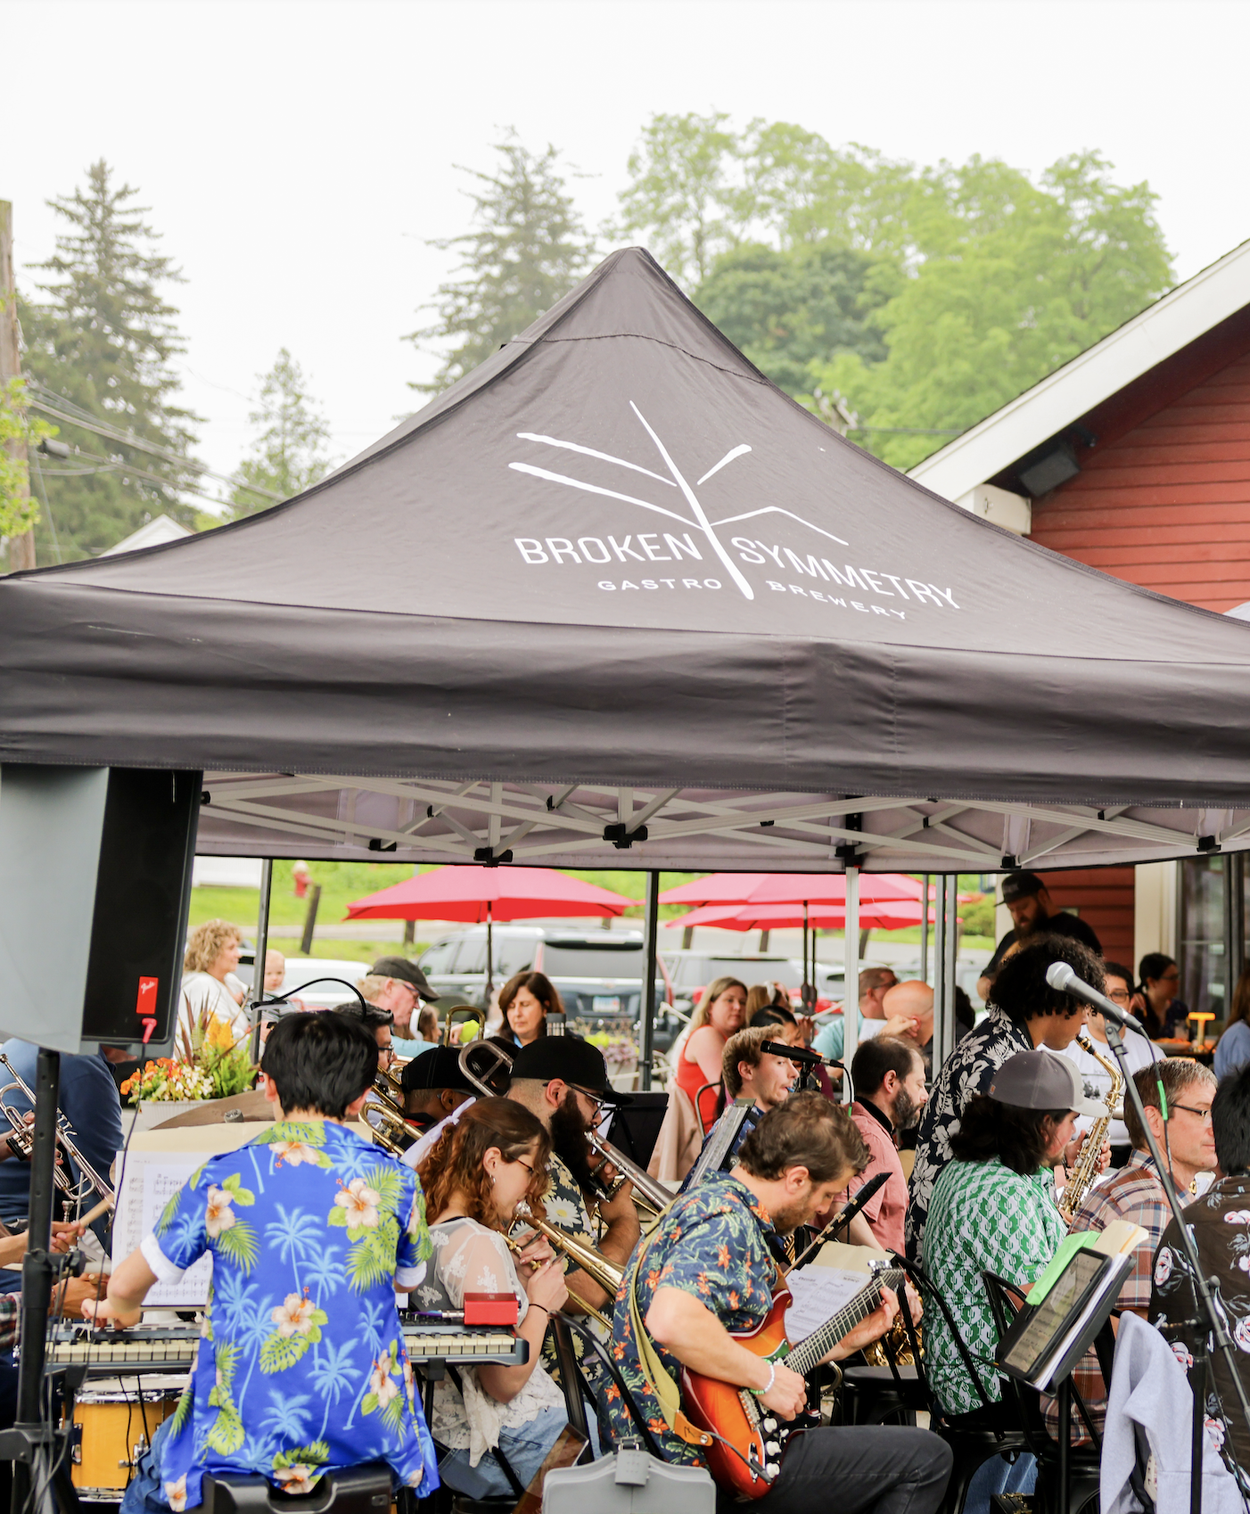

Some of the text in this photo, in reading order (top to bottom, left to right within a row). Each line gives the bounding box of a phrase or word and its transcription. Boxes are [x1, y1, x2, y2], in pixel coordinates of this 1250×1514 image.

[514, 534, 961, 609] BROKEN SYMMETRY
[597, 578, 907, 620] GASTRO BREWERY
